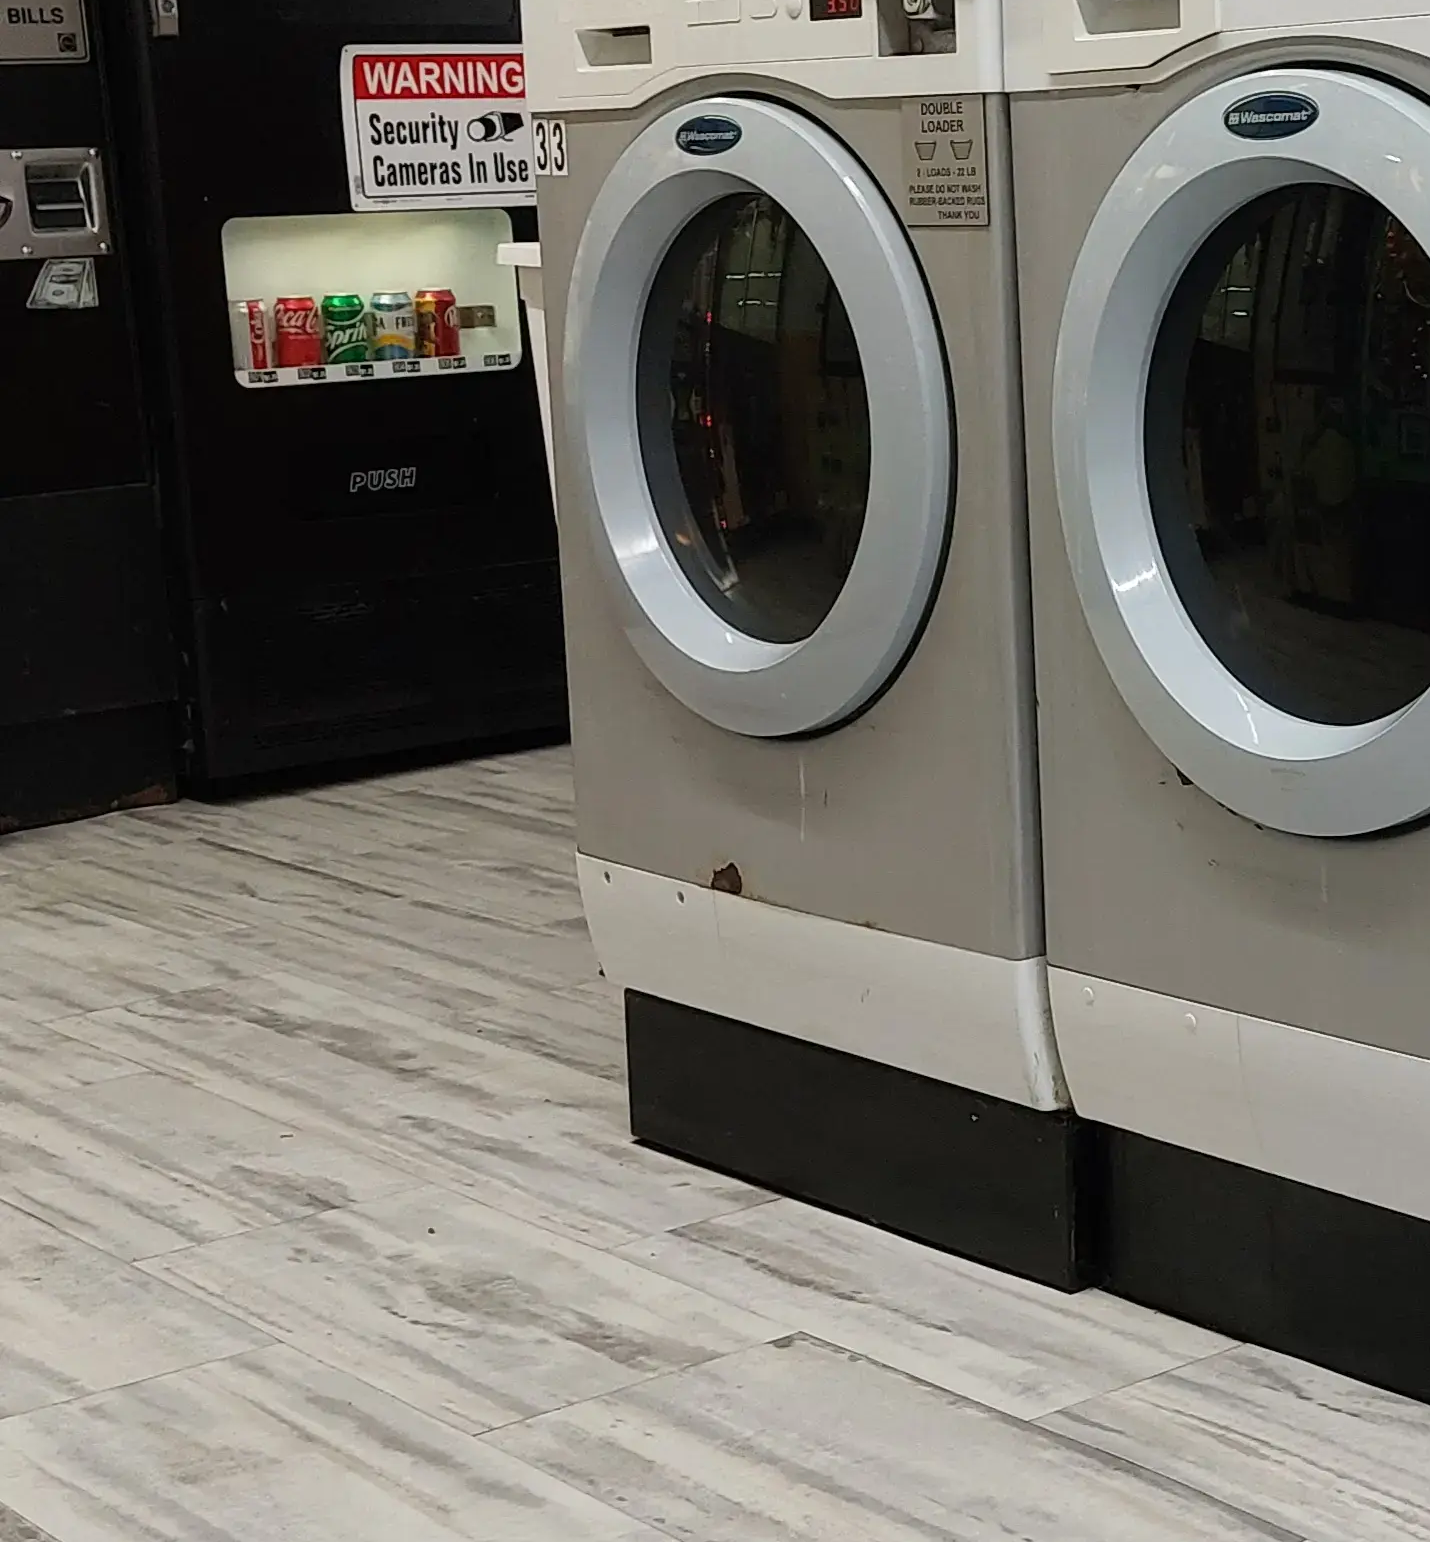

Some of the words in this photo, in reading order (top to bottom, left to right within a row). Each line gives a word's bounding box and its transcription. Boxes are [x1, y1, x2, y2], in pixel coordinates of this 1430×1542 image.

[7, 6, 65, 25] BILLS
[362, 60, 524, 96] WARNING
[920, 101, 964, 116] DOUBLE
[1240, 110, 1310, 125] Wascomat
[368, 111, 459, 150] Security
[921, 119, 965, 134] LOADER
[534, 121, 566, 173] 33
[372, 155, 463, 187] Cameras
[468, 152, 488, 184] In
[492, 151, 529, 183] Use
[926, 167, 951, 178] LOADS
[966, 166, 977, 177] LB
[935, 184, 945, 194] DO
[946, 184, 960, 194] NOT
[937, 210, 962, 220] THANK
[963, 210, 980, 221] YOU
[349, 467, 417, 493] PUSH
